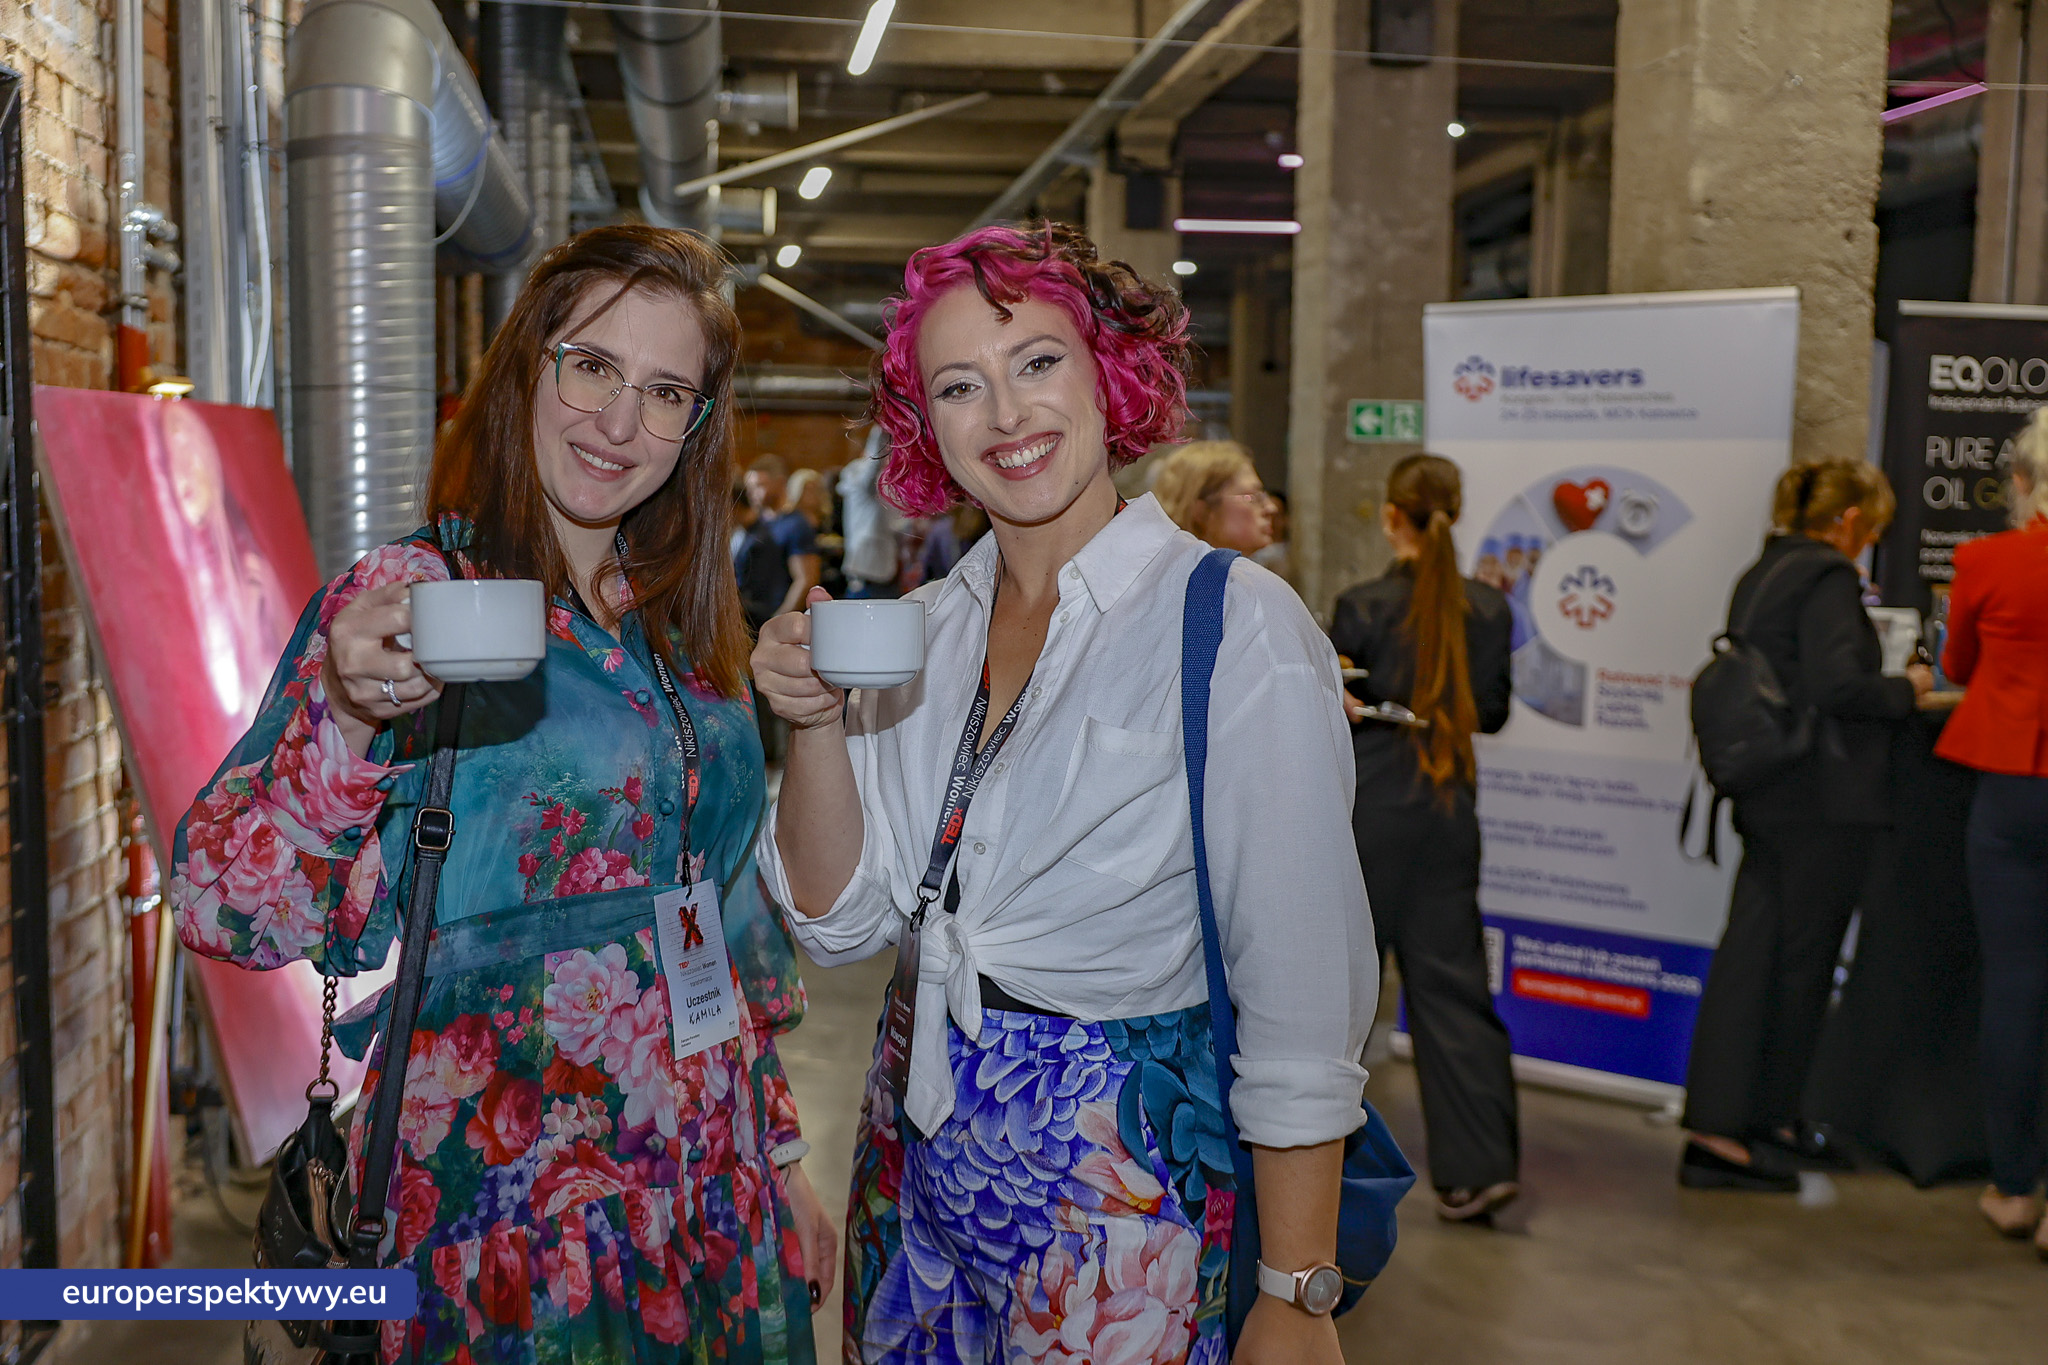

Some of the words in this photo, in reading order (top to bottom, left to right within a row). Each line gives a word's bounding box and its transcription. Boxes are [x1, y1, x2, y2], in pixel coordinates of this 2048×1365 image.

[1501, 366, 1646, 389] lifesavers
[1925, 435, 1994, 471] PURE
[1922, 475, 1971, 511] OIL
[653, 652, 674, 694] Women
[669, 695, 697, 758] Nikiszowiec
[956, 696, 988, 772] Nikiszowiec
[940, 806, 964, 846] TEDx
[962, 725, 1007, 800] Nikiszowiec
[686, 986, 722, 1009] Uczestnik
[688, 1004, 722, 1025] KAMILA
